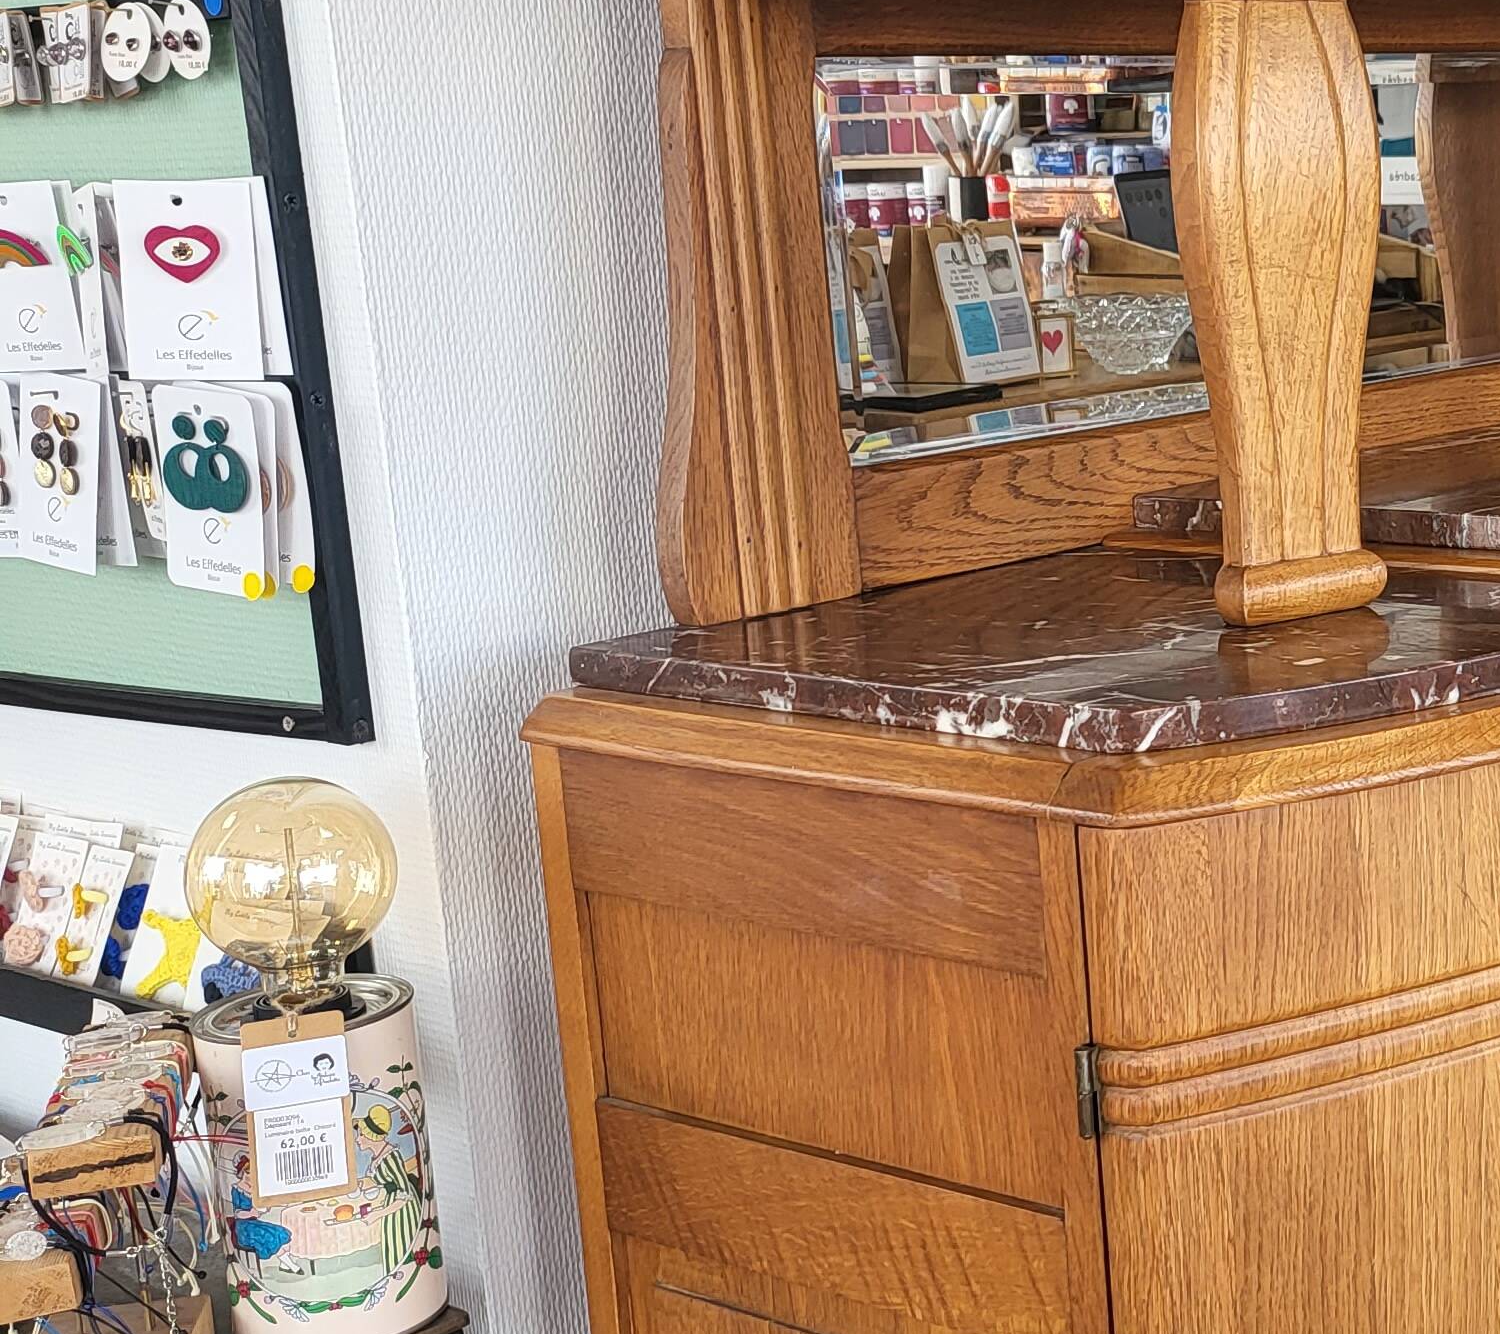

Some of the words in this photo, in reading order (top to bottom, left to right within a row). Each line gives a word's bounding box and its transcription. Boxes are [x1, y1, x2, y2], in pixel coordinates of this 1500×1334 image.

[6, 342, 21, 353] Les
[156, 349, 176, 360] Les
[32, 531, 44, 544] Les
[186, 556, 201, 568] Les
[280, 1135, 316, 1149] 62,00
[319, 1132, 327, 1143] €
